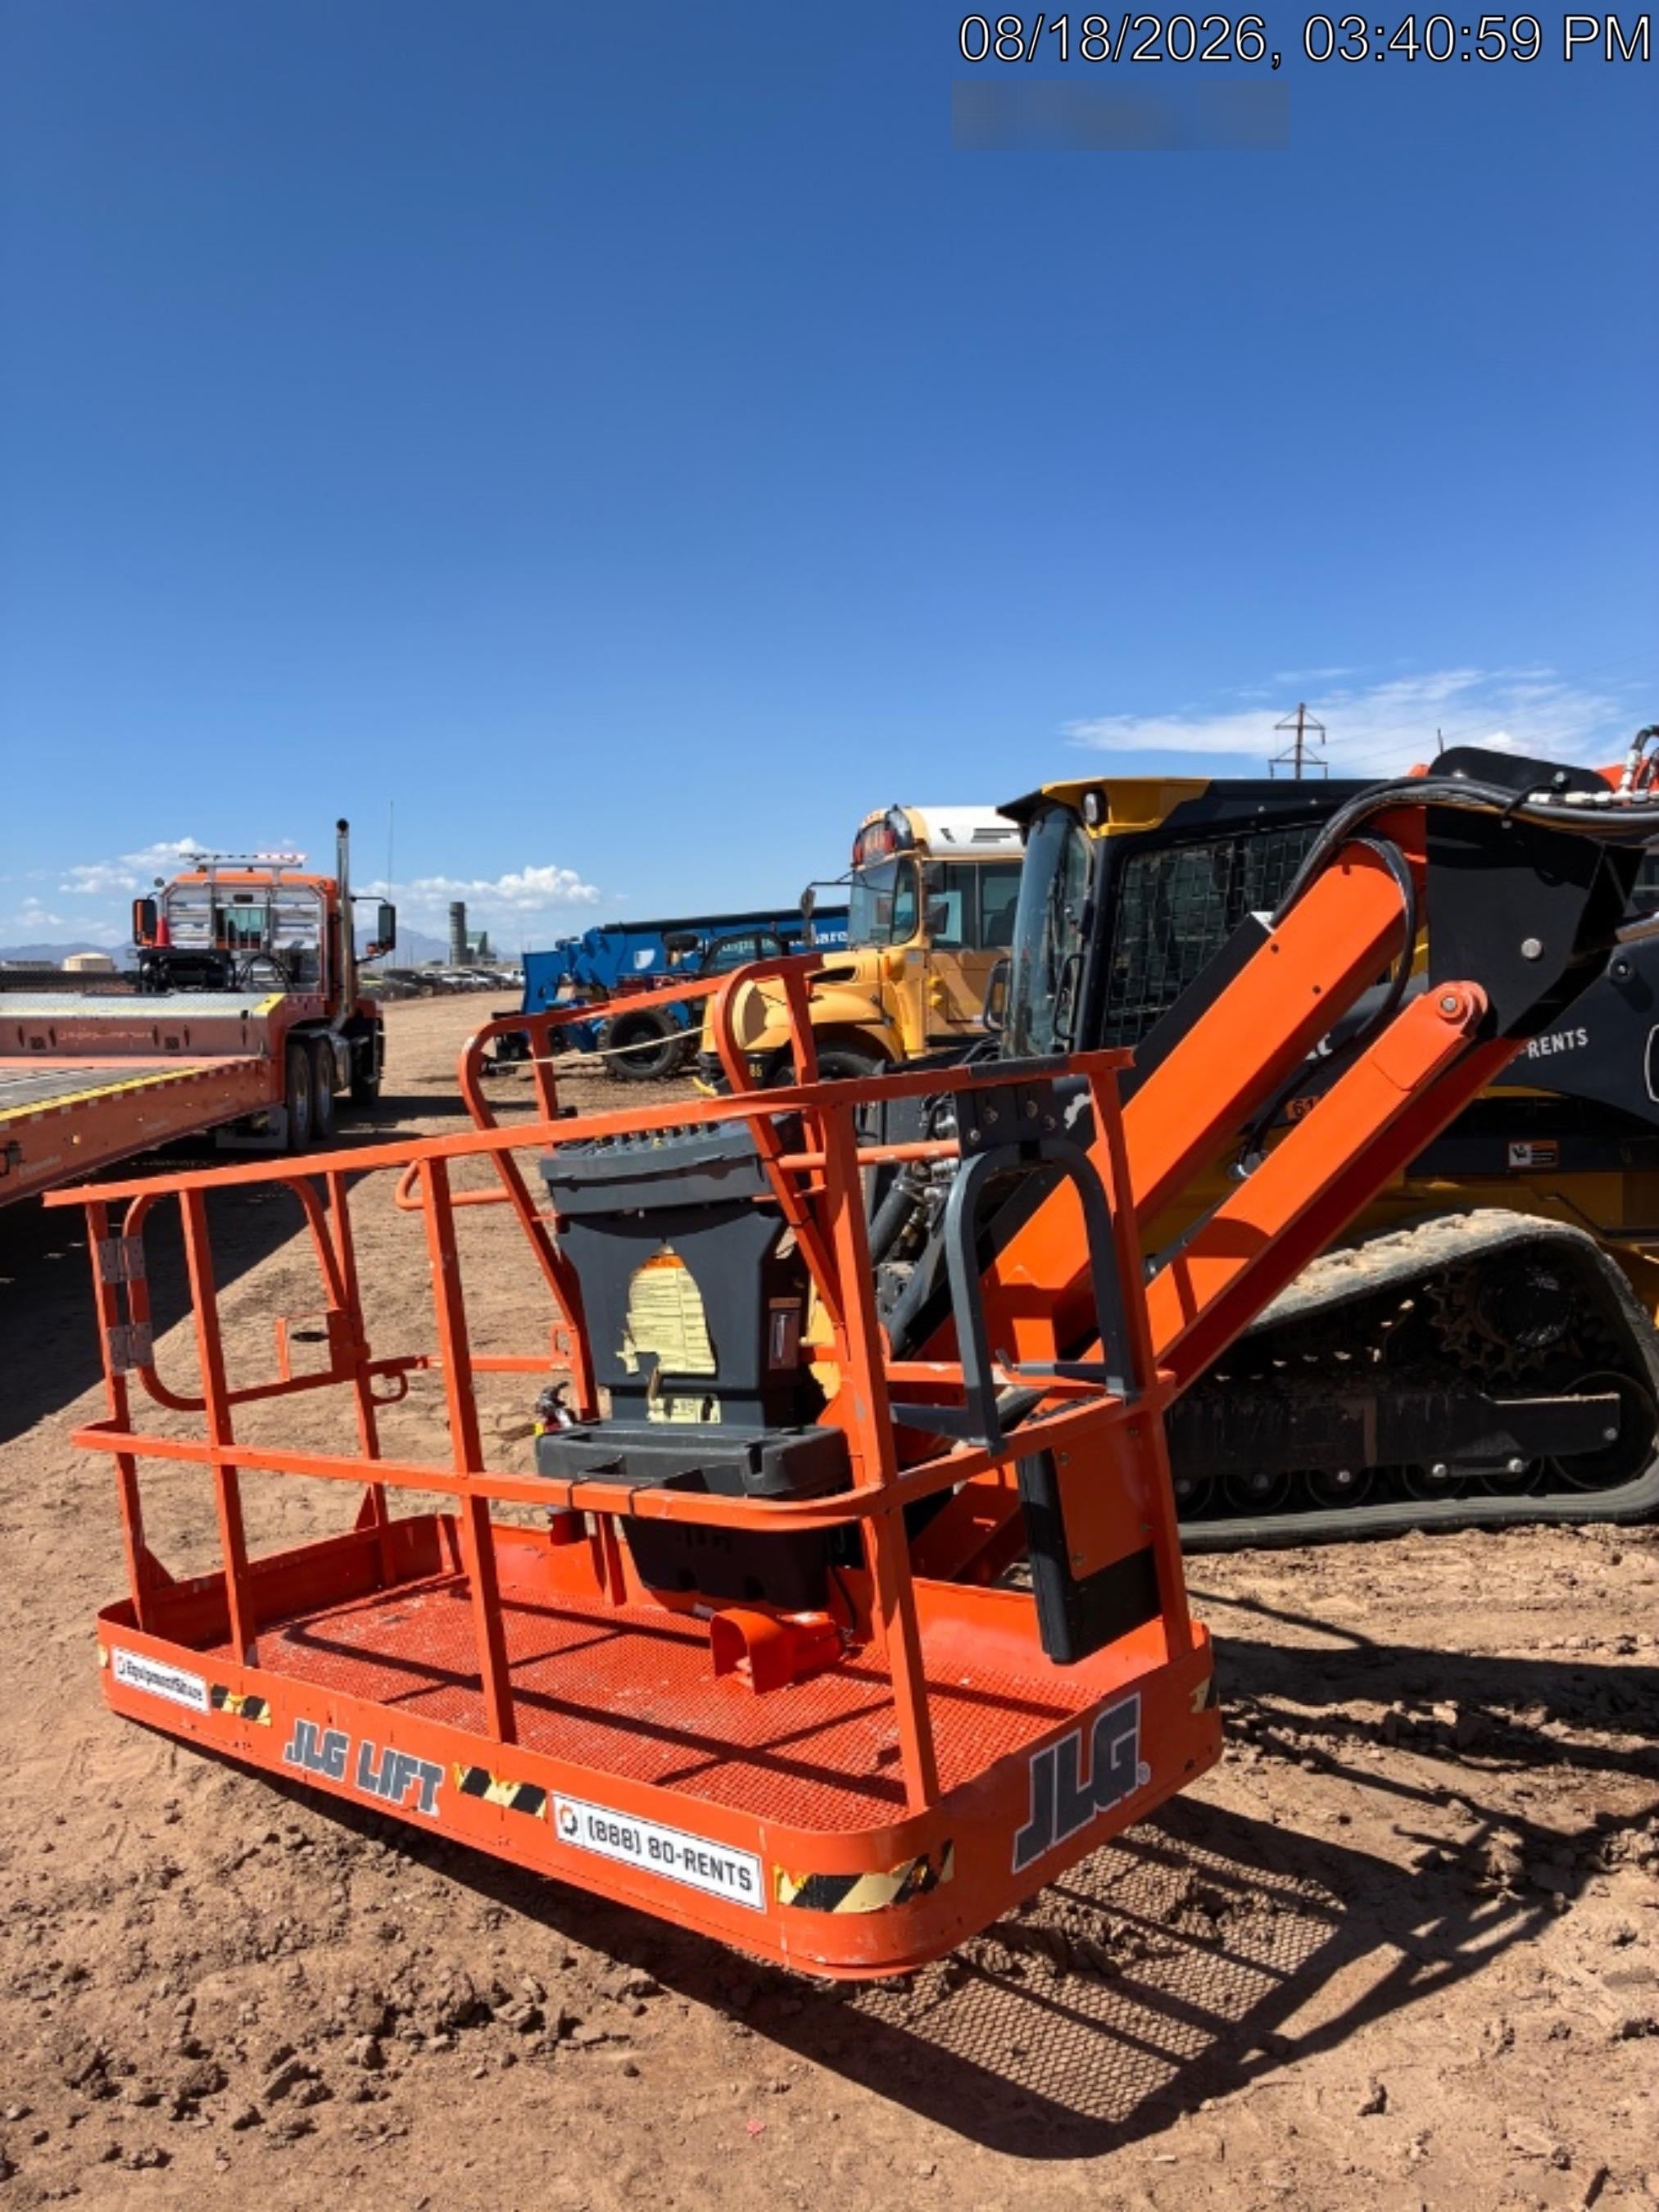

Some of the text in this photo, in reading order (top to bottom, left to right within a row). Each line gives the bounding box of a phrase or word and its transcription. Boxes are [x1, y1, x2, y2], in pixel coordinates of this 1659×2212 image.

[282, 1718, 446, 1817] JLG LIFT
[587, 1815, 753, 1892] (888) 80-RENTS
